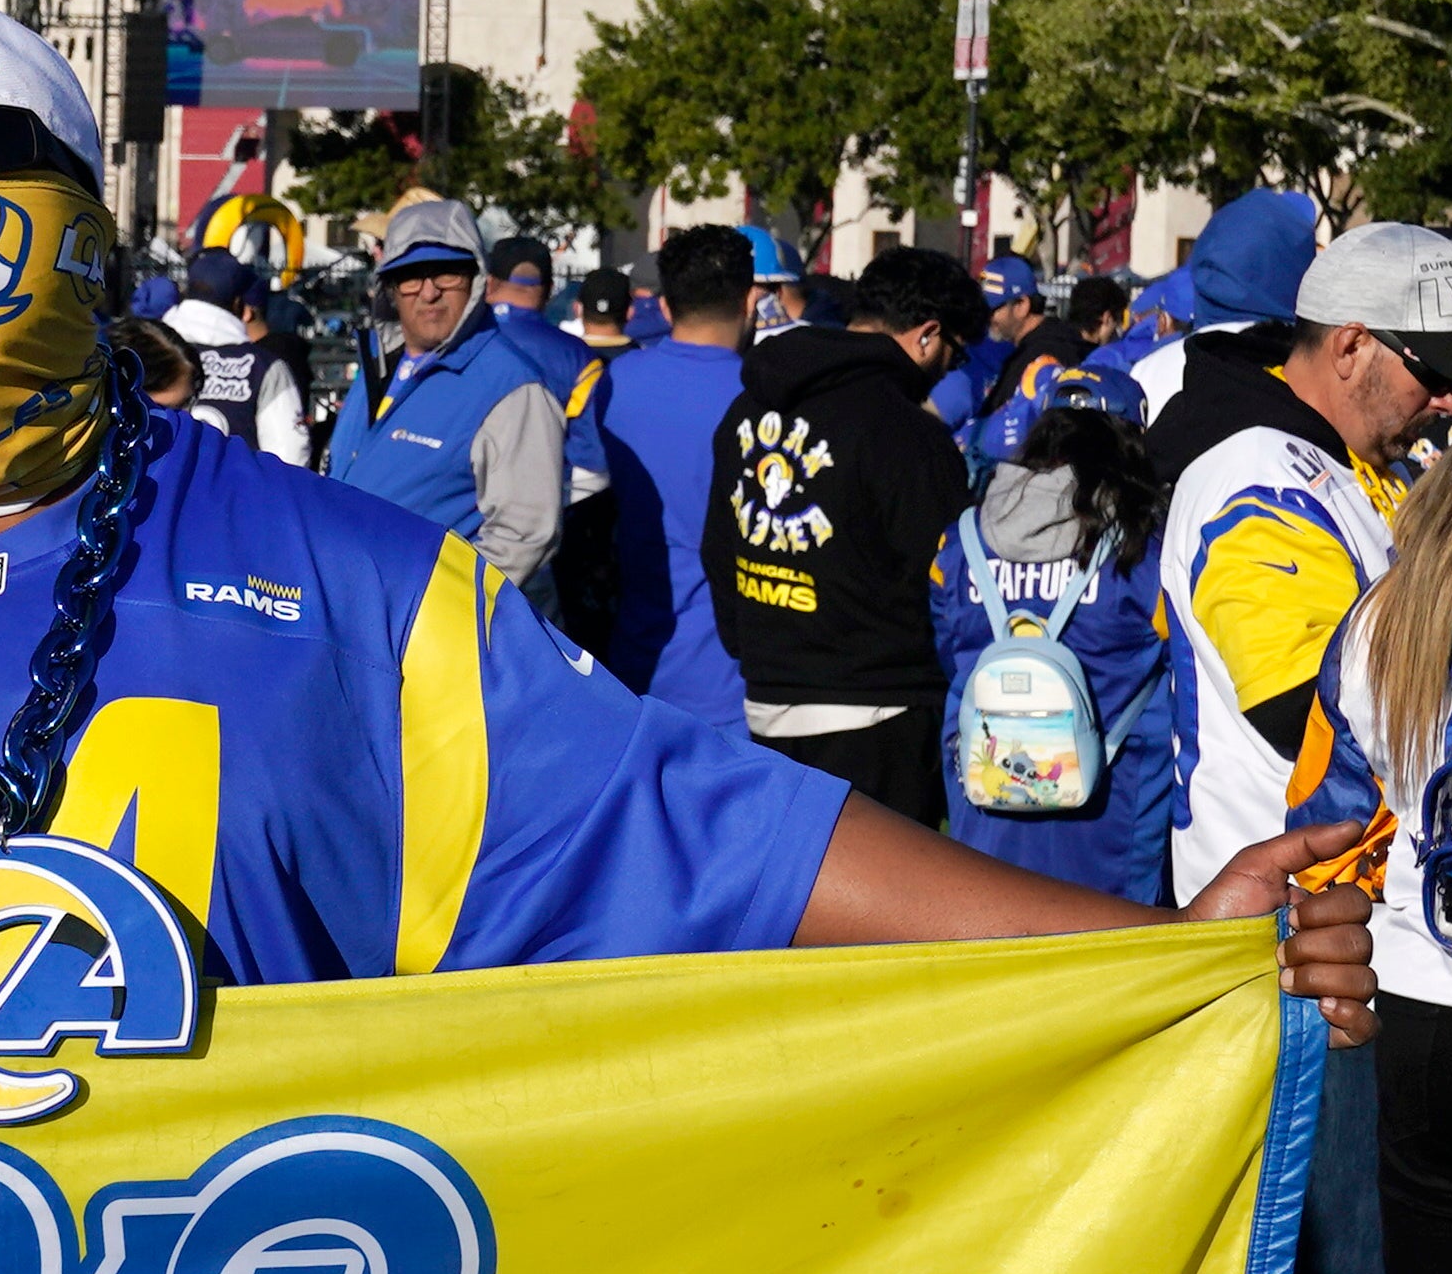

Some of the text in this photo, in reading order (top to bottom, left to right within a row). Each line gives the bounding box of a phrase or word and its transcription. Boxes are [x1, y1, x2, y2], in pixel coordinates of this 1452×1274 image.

[200, 350, 255, 377] Bowl
[185, 582, 301, 622] RAMS
[735, 570, 818, 613] RAMS
